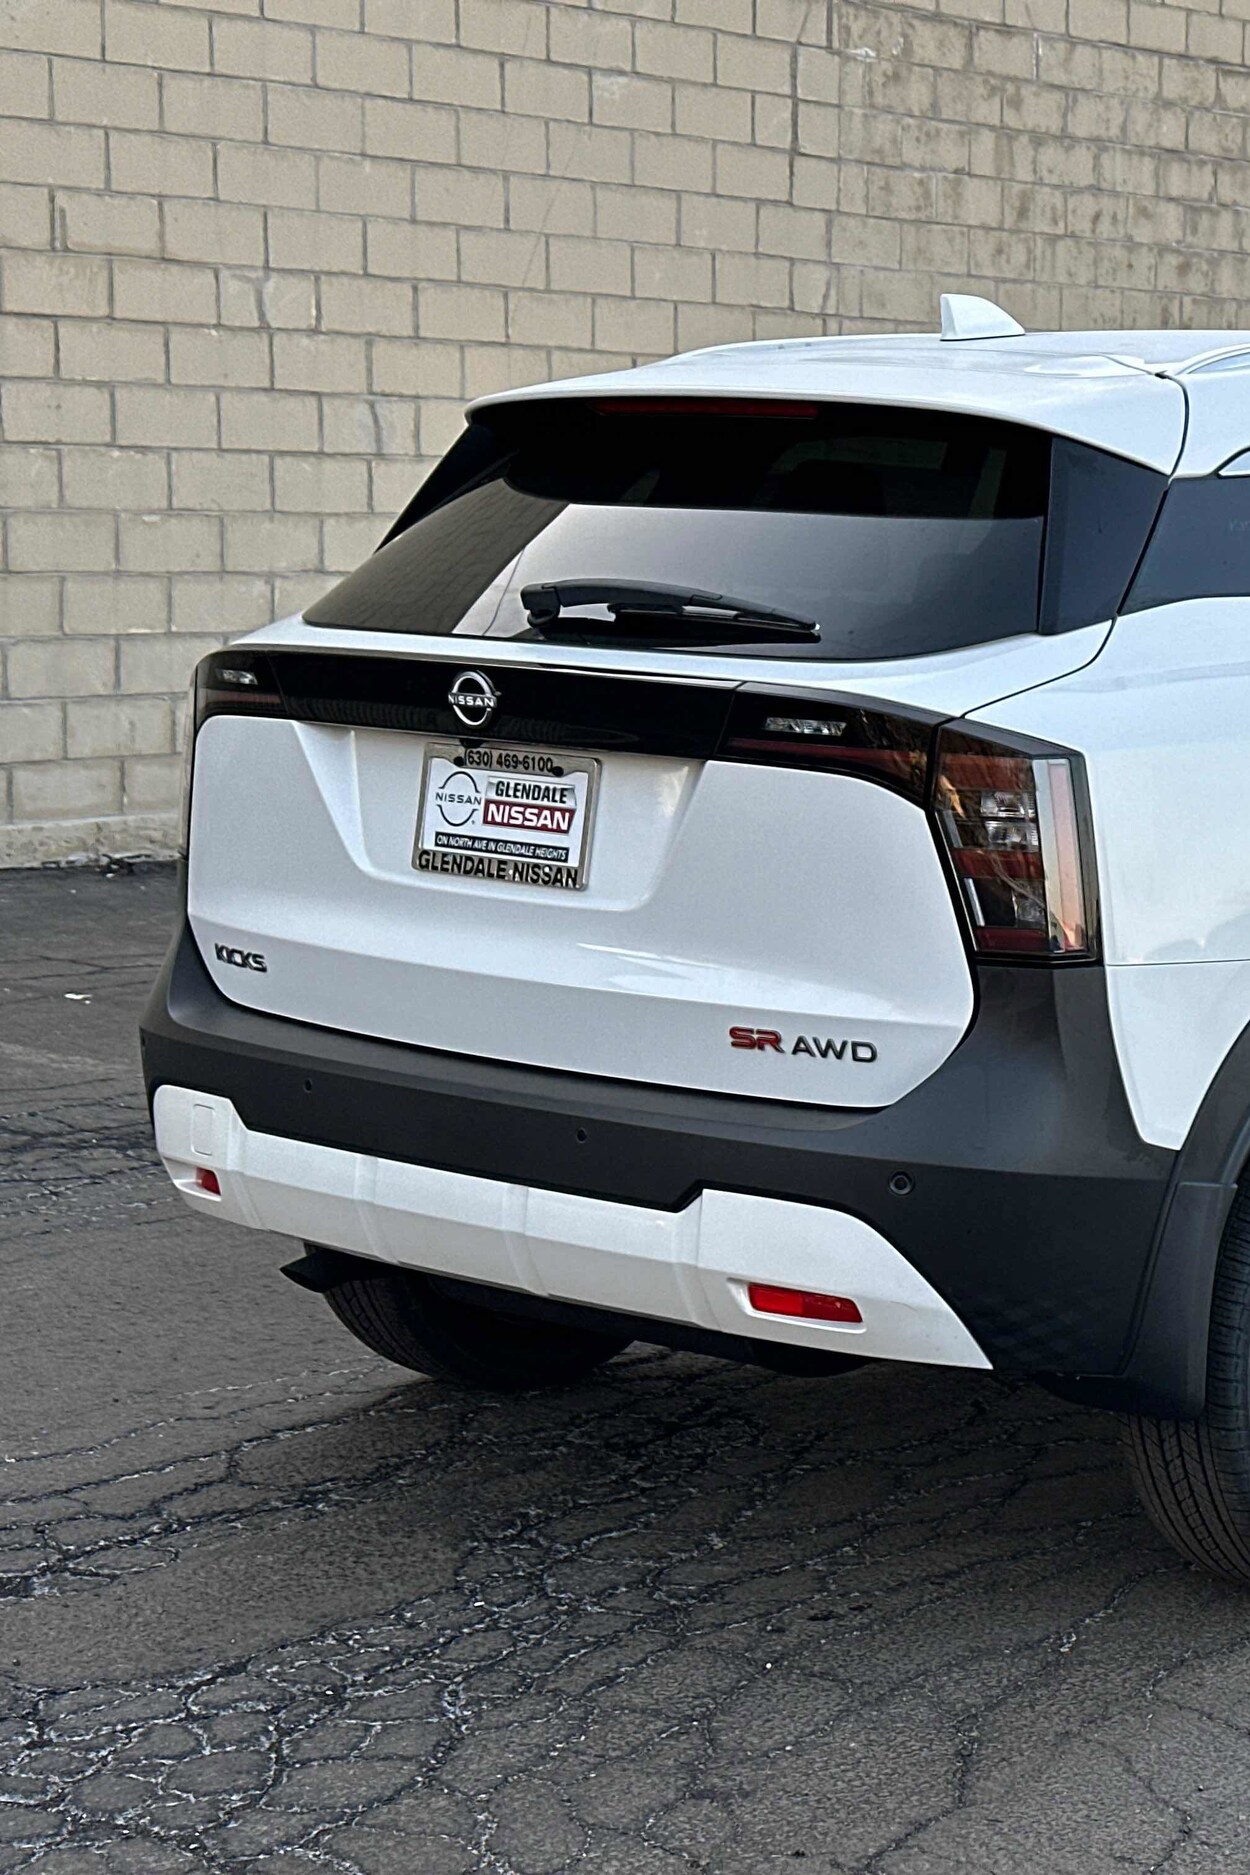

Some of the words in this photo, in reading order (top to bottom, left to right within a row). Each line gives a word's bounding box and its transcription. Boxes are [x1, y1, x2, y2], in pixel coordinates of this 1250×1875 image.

[448, 694, 494, 707] NISSAN
[464, 748, 493, 769] (630)
[495, 752, 554, 773] 469-6100
[435, 792, 482, 806] NISSAN
[495, 780, 568, 804] GLENDALE
[487, 803, 570, 831] NISSAN
[448, 836, 473, 849] NORTH
[497, 842, 535, 856] GLENDALE
[534, 846, 568, 861] HEIGHTS
[418, 849, 508, 879] GLENDALE
[512, 861, 579, 889] NISSAN
[214, 942, 268, 973] KICKS
[728, 1025, 786, 1054] SR
[791, 1034, 878, 1064] AWD
